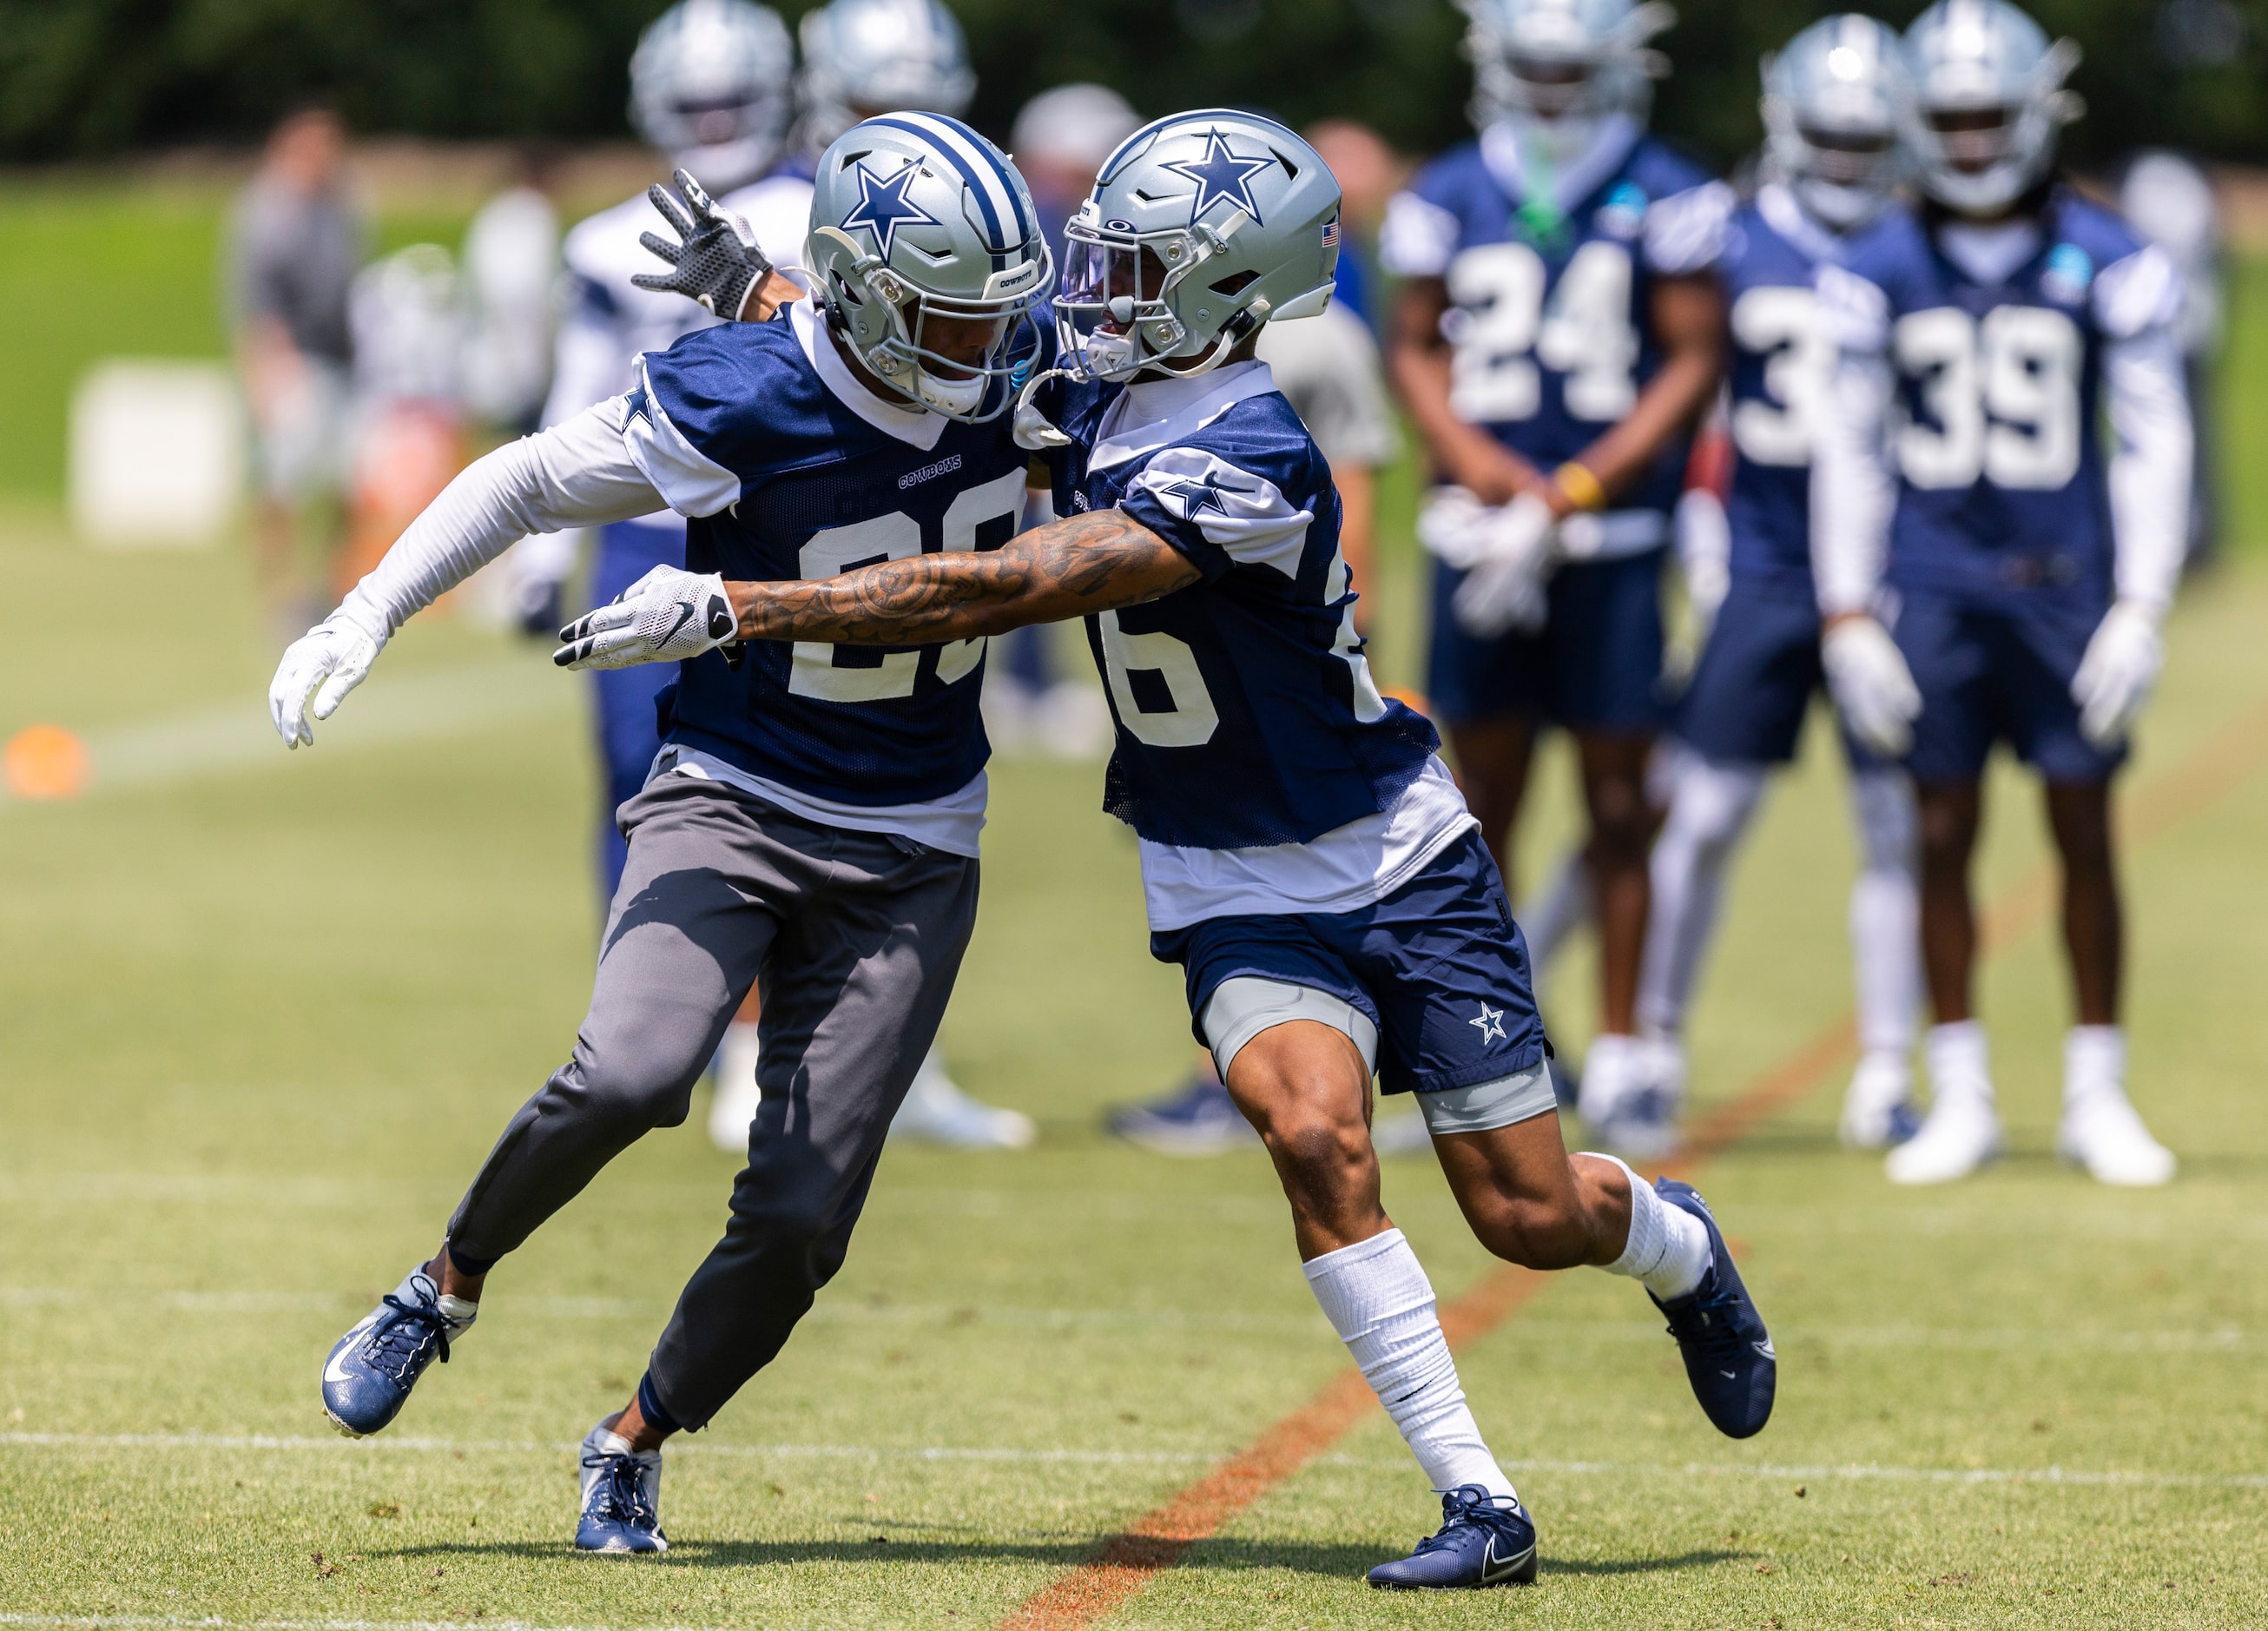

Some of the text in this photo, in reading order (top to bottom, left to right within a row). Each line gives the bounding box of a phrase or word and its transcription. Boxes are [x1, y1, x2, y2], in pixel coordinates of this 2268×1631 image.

[1000, 269, 1032, 287] COWBOYS
[1448, 242, 1637, 421] 24
[1898, 306, 2080, 489] 39
[899, 454, 962, 489] COWBOYS
